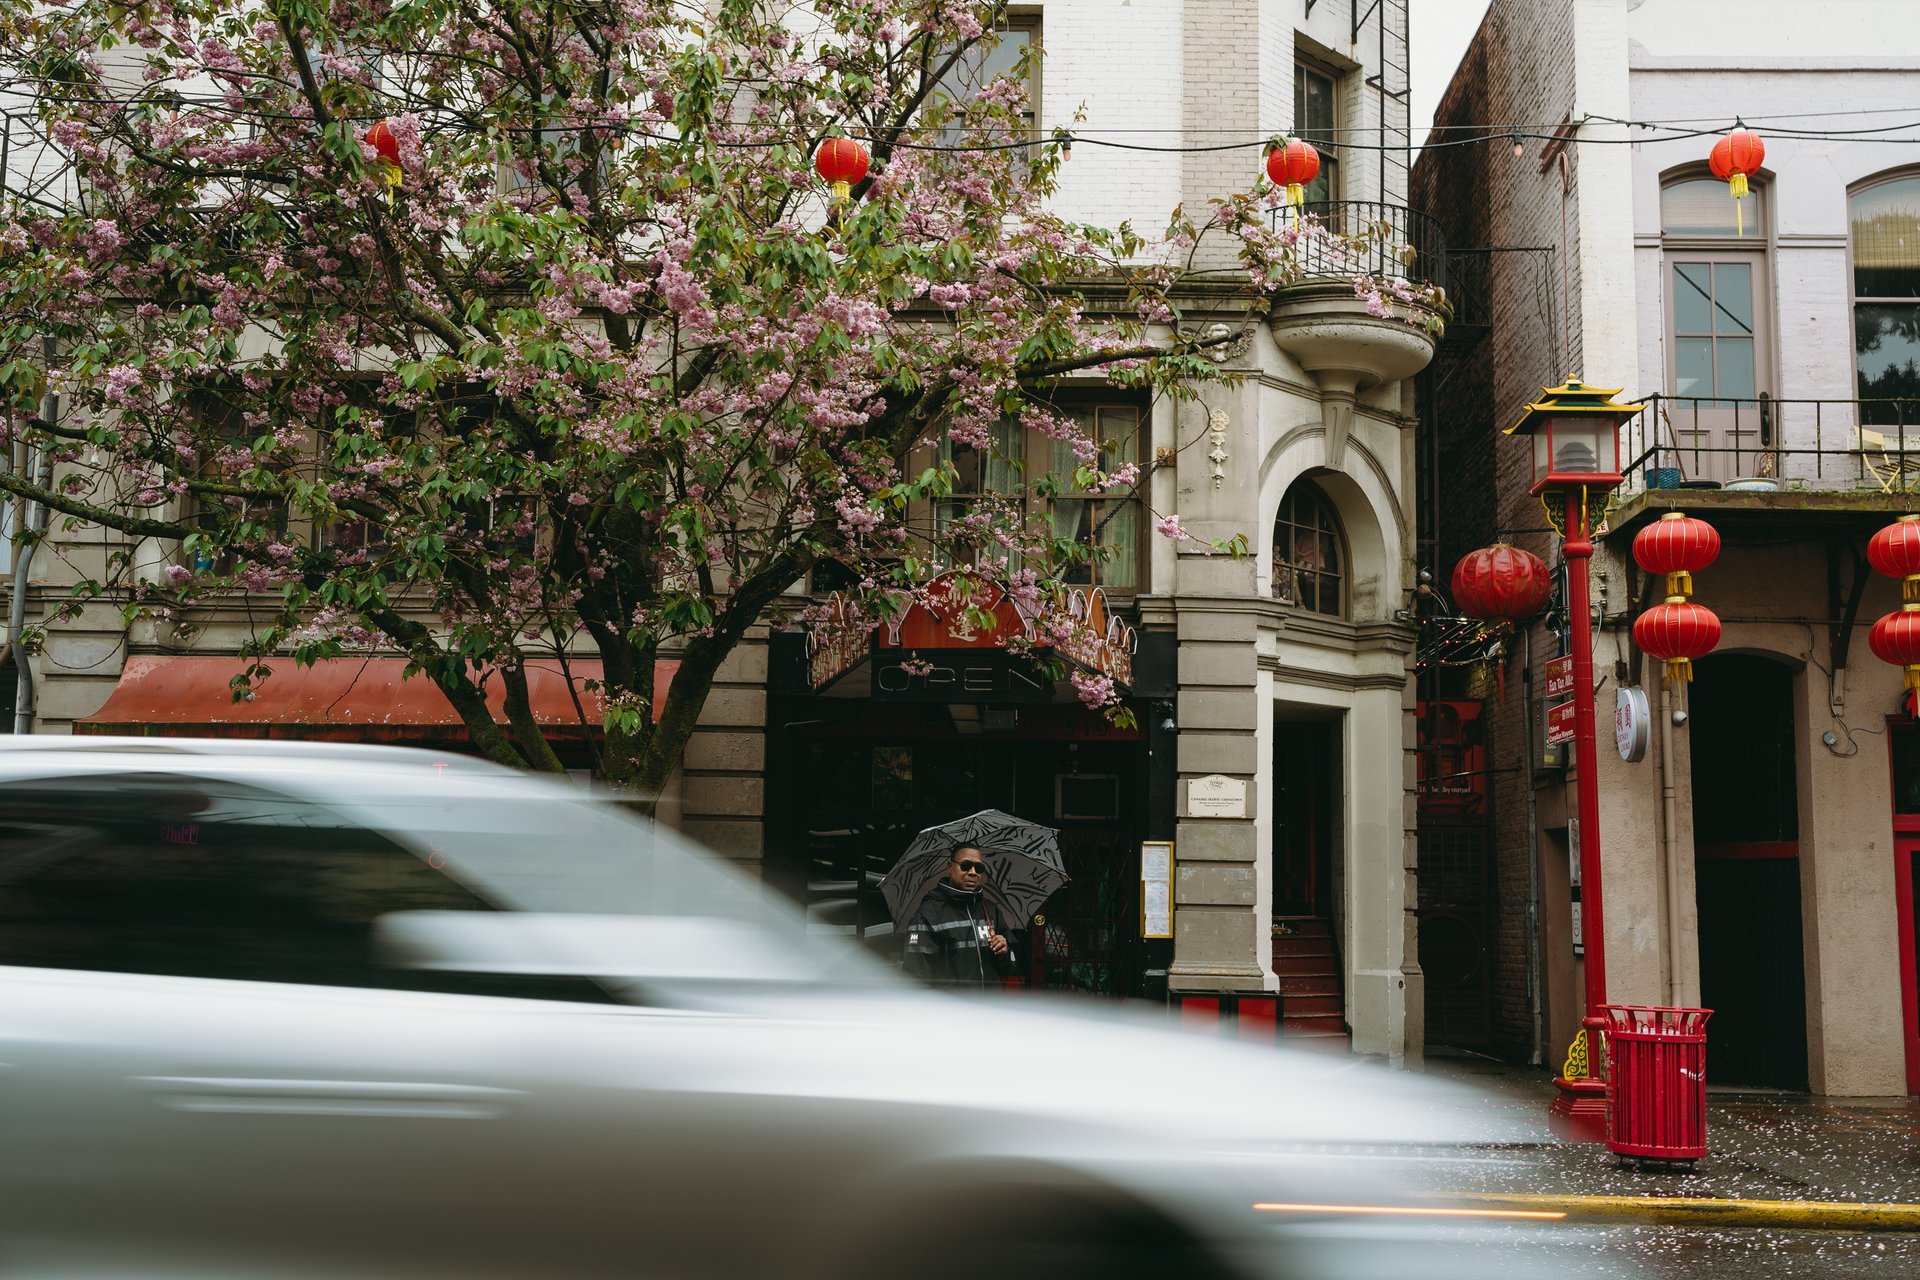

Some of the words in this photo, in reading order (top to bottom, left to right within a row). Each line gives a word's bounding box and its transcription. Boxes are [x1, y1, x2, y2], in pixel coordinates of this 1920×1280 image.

[879, 665, 1044, 691] OPEN
[1065, 719, 1108, 737] 549
[1451, 786, 1471, 795] courtyard
